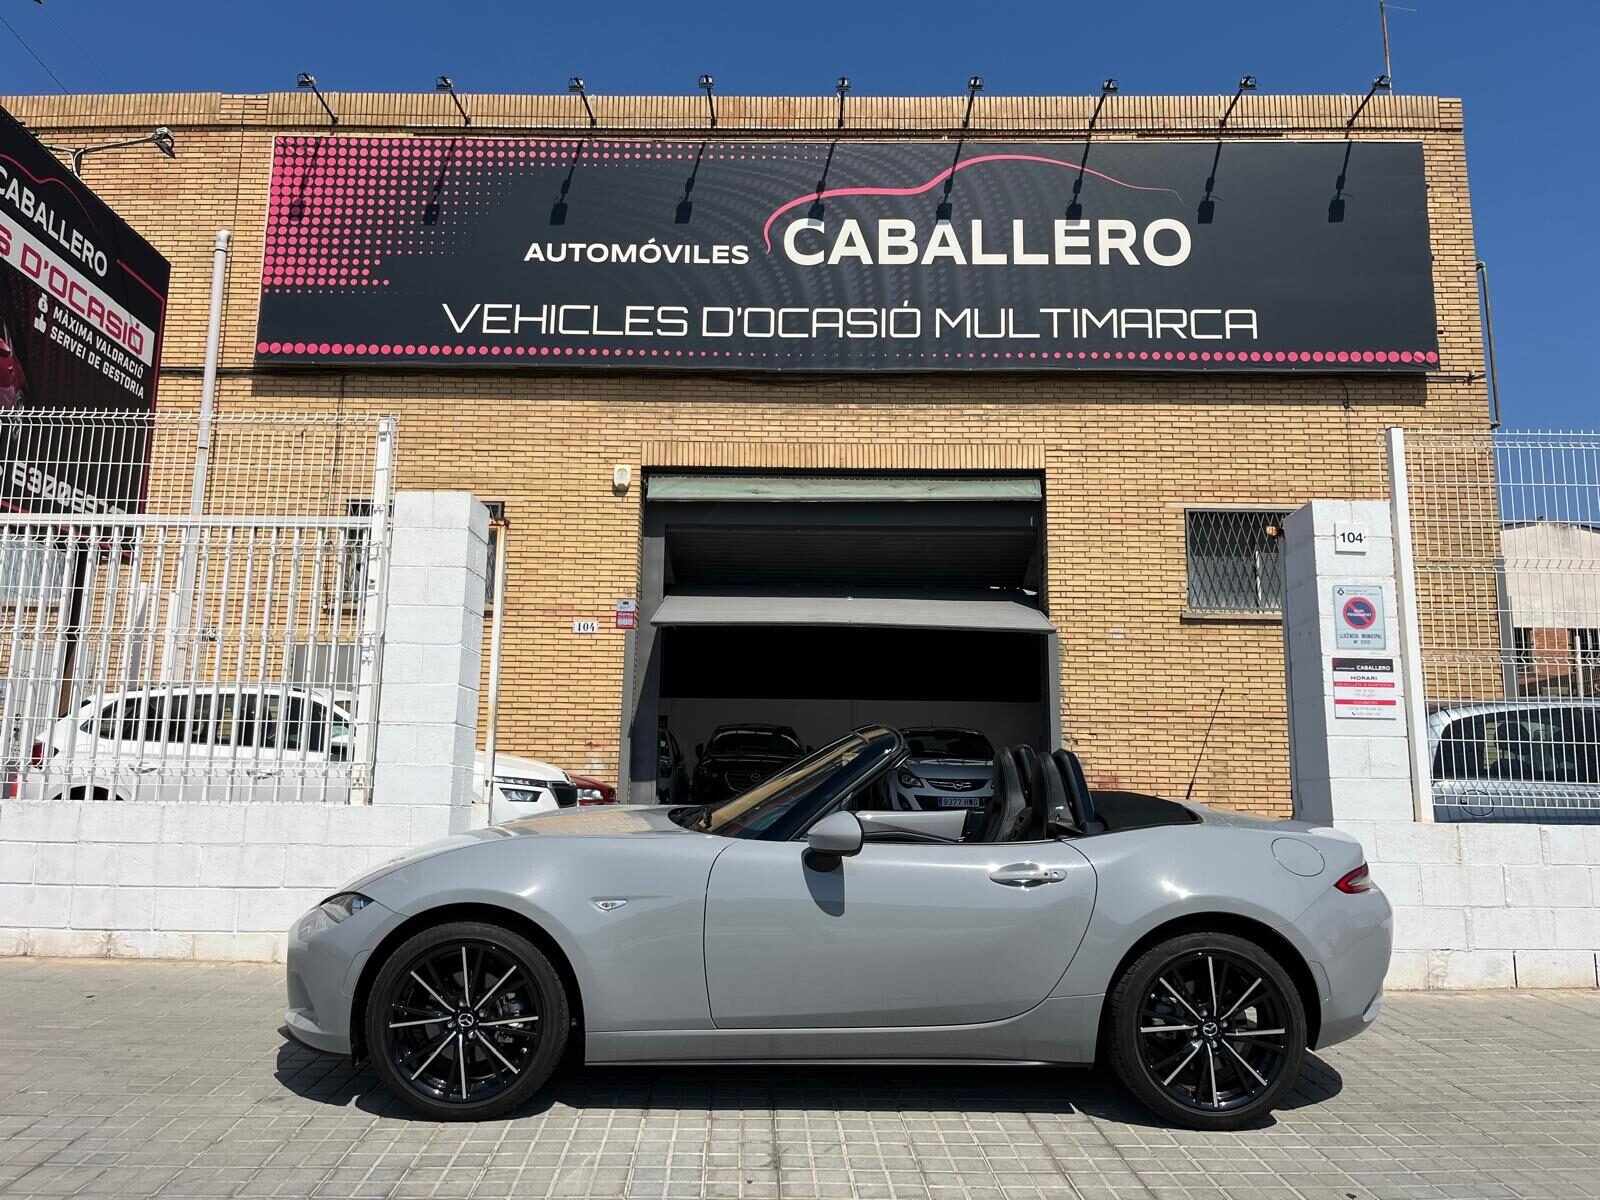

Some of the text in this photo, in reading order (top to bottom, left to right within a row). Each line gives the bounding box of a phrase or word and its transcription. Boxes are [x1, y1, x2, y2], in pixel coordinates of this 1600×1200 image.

[523, 218, 1192, 267] AUTOMÓVILES CABALLERO
[20, 243, 144, 356] D'OCASIÓ
[441, 299, 1259, 340] VEHICLES D'OCASIÓ MULTIMARCA
[50, 326, 144, 400] SERVEI DE GESTORIA
[53, 306, 144, 379] MÀXIMA VALORACIÓ
[1339, 532, 1364, 543] 104
[577, 622, 595, 632] 104
